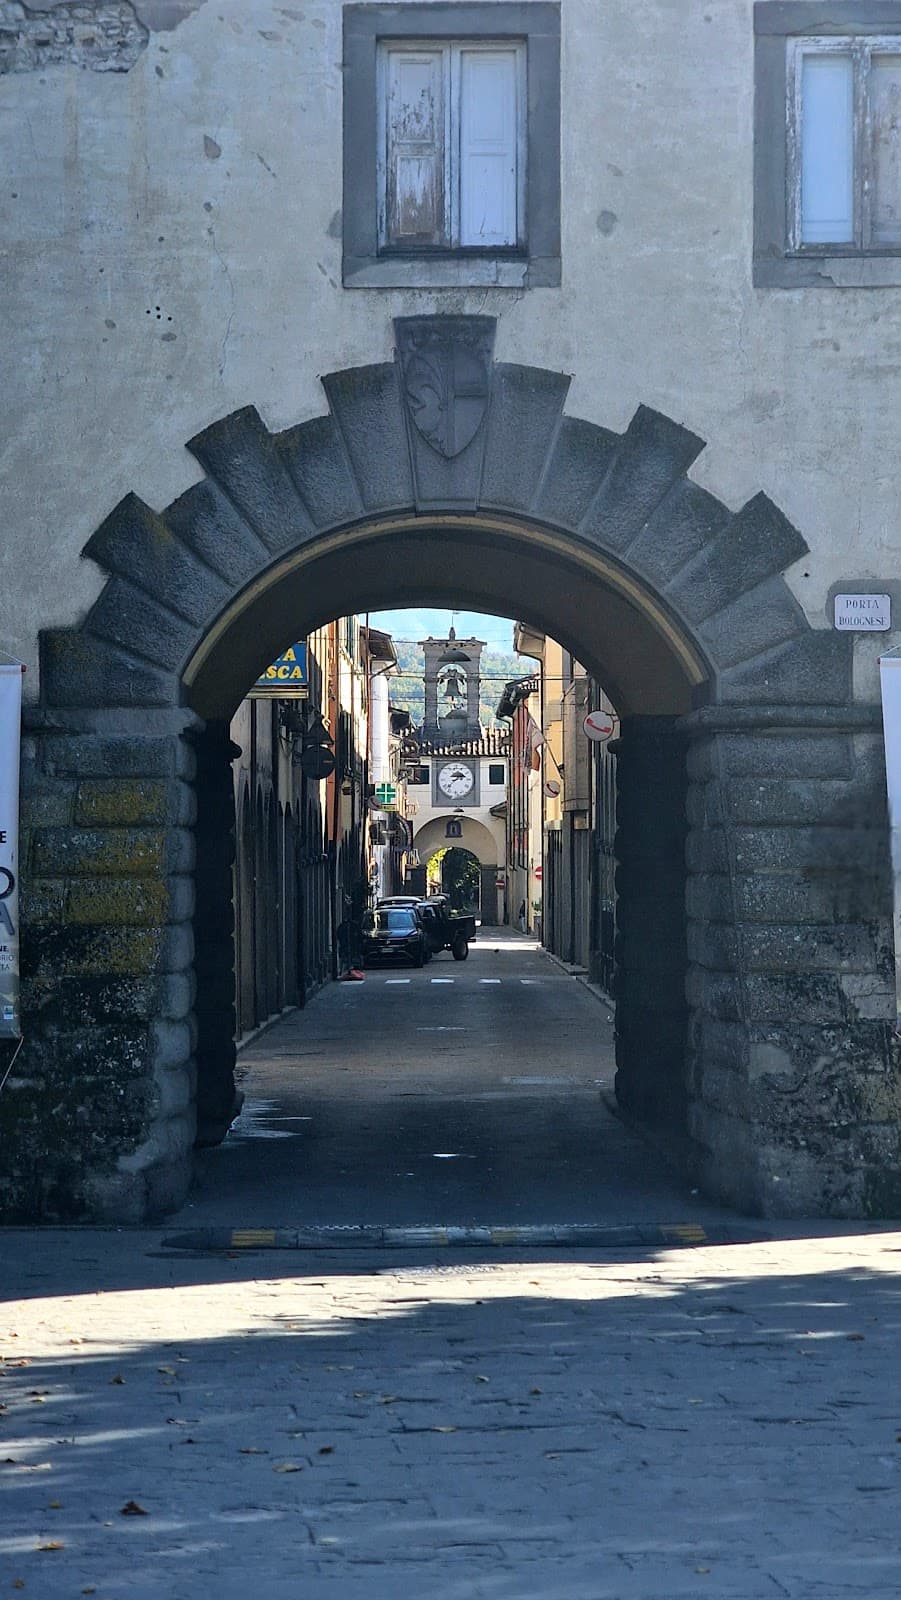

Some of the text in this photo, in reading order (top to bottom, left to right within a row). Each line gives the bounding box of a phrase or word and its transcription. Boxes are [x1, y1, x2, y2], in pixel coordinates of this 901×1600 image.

[846, 600, 879, 609] PORTA
[839, 616, 885, 625] BOLOGNESE
[277, 648, 297, 661] A
[259, 665, 304, 679] SCA
